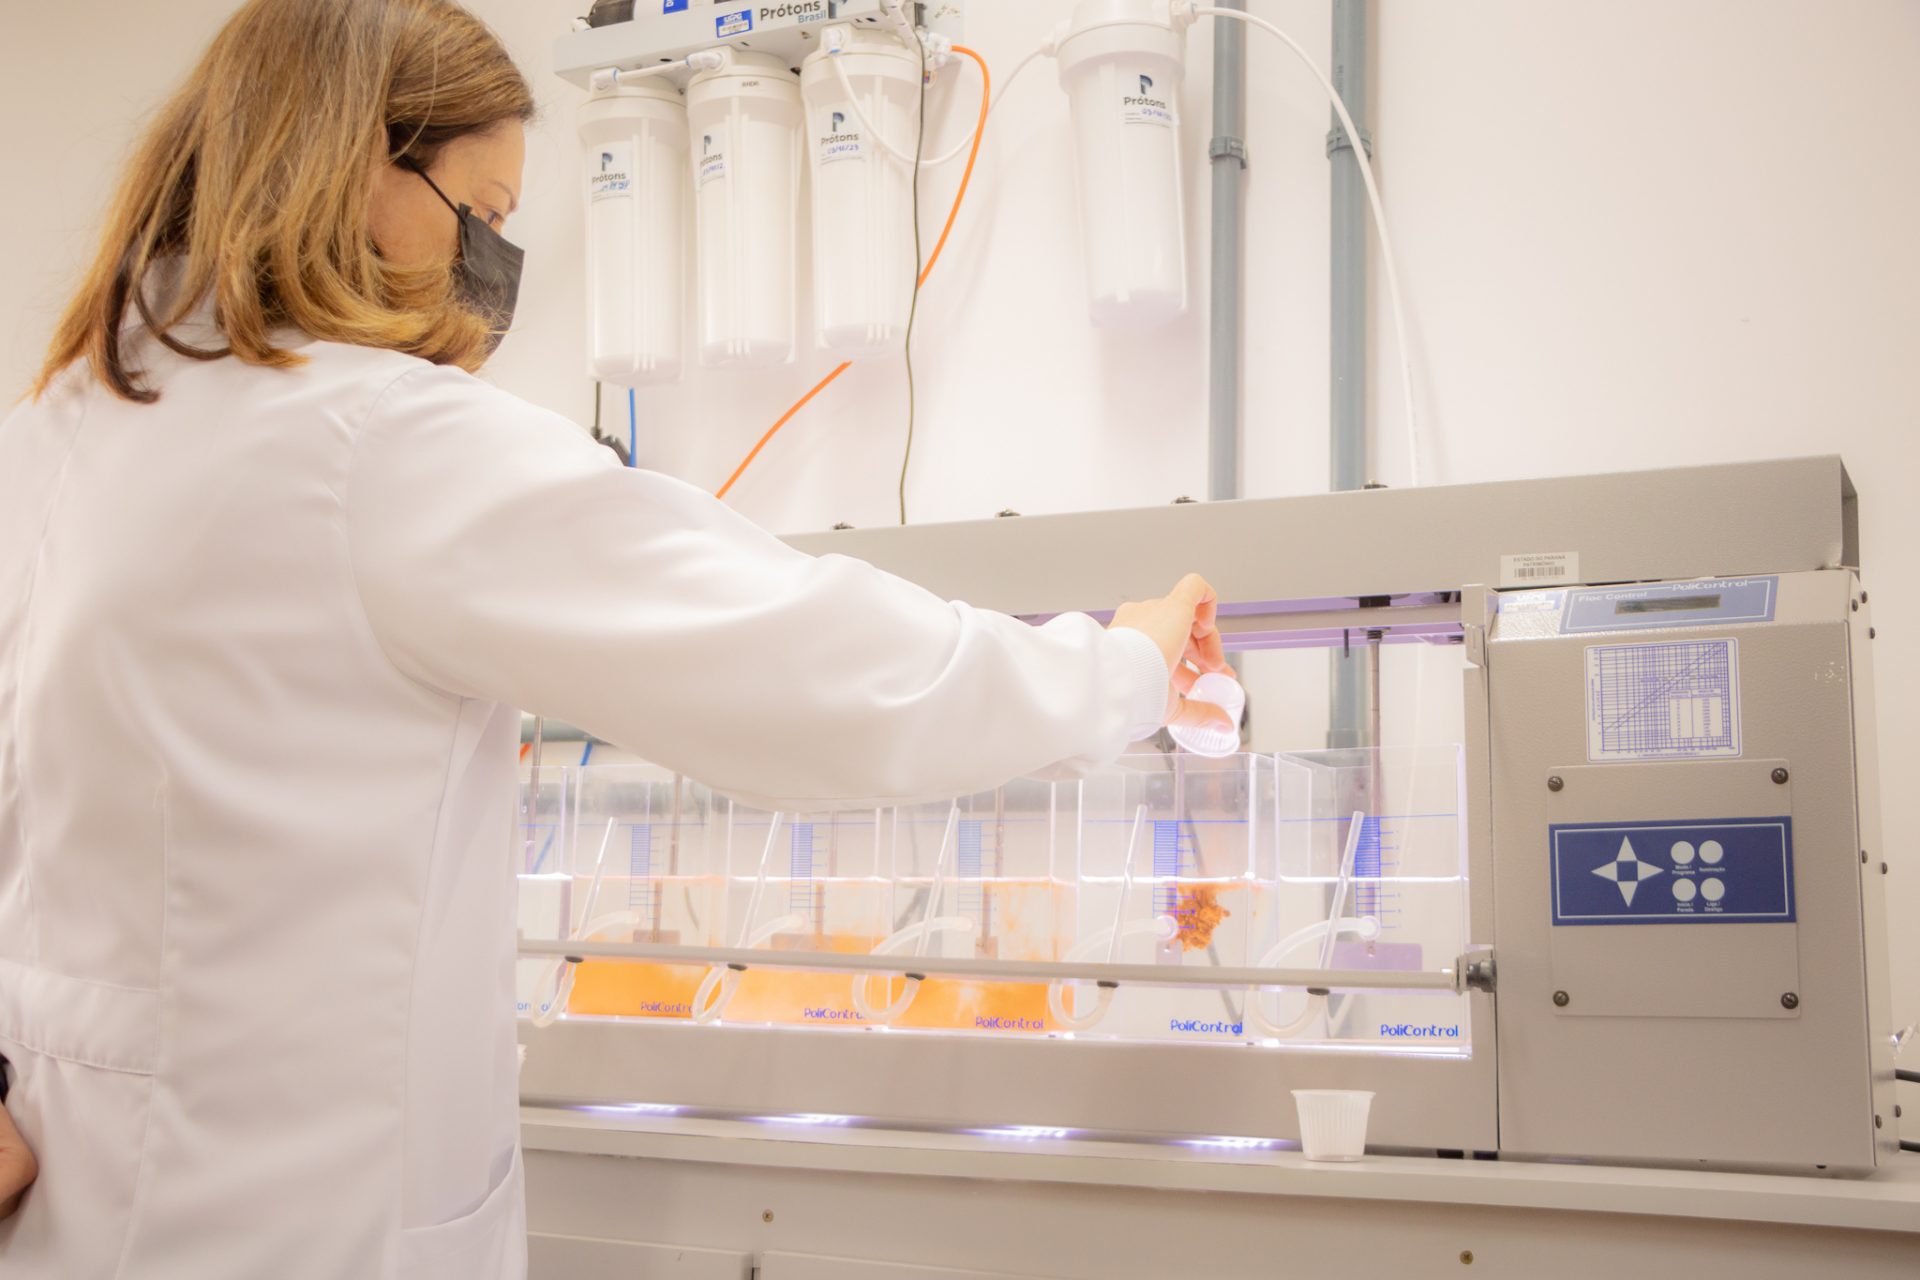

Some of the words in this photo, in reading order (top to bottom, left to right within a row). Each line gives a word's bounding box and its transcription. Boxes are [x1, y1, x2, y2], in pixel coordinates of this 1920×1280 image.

[760, 0, 821, 20] Prótons
[798, 10, 826, 24] Brasil
[1124, 96, 1166, 109] Prótons
[821, 133, 859, 146] Prótons
[592, 172, 627, 184] Prótons
[1672, 579, 1748, 591] PoliControl
[1606, 591, 1648, 601] Control
[804, 1007, 864, 1020] PoliContro
[975, 1015, 1044, 1030] PoliControl
[1170, 1018, 1243, 1035] PoliControl
[1380, 1023, 1458, 1037] PoliControl
